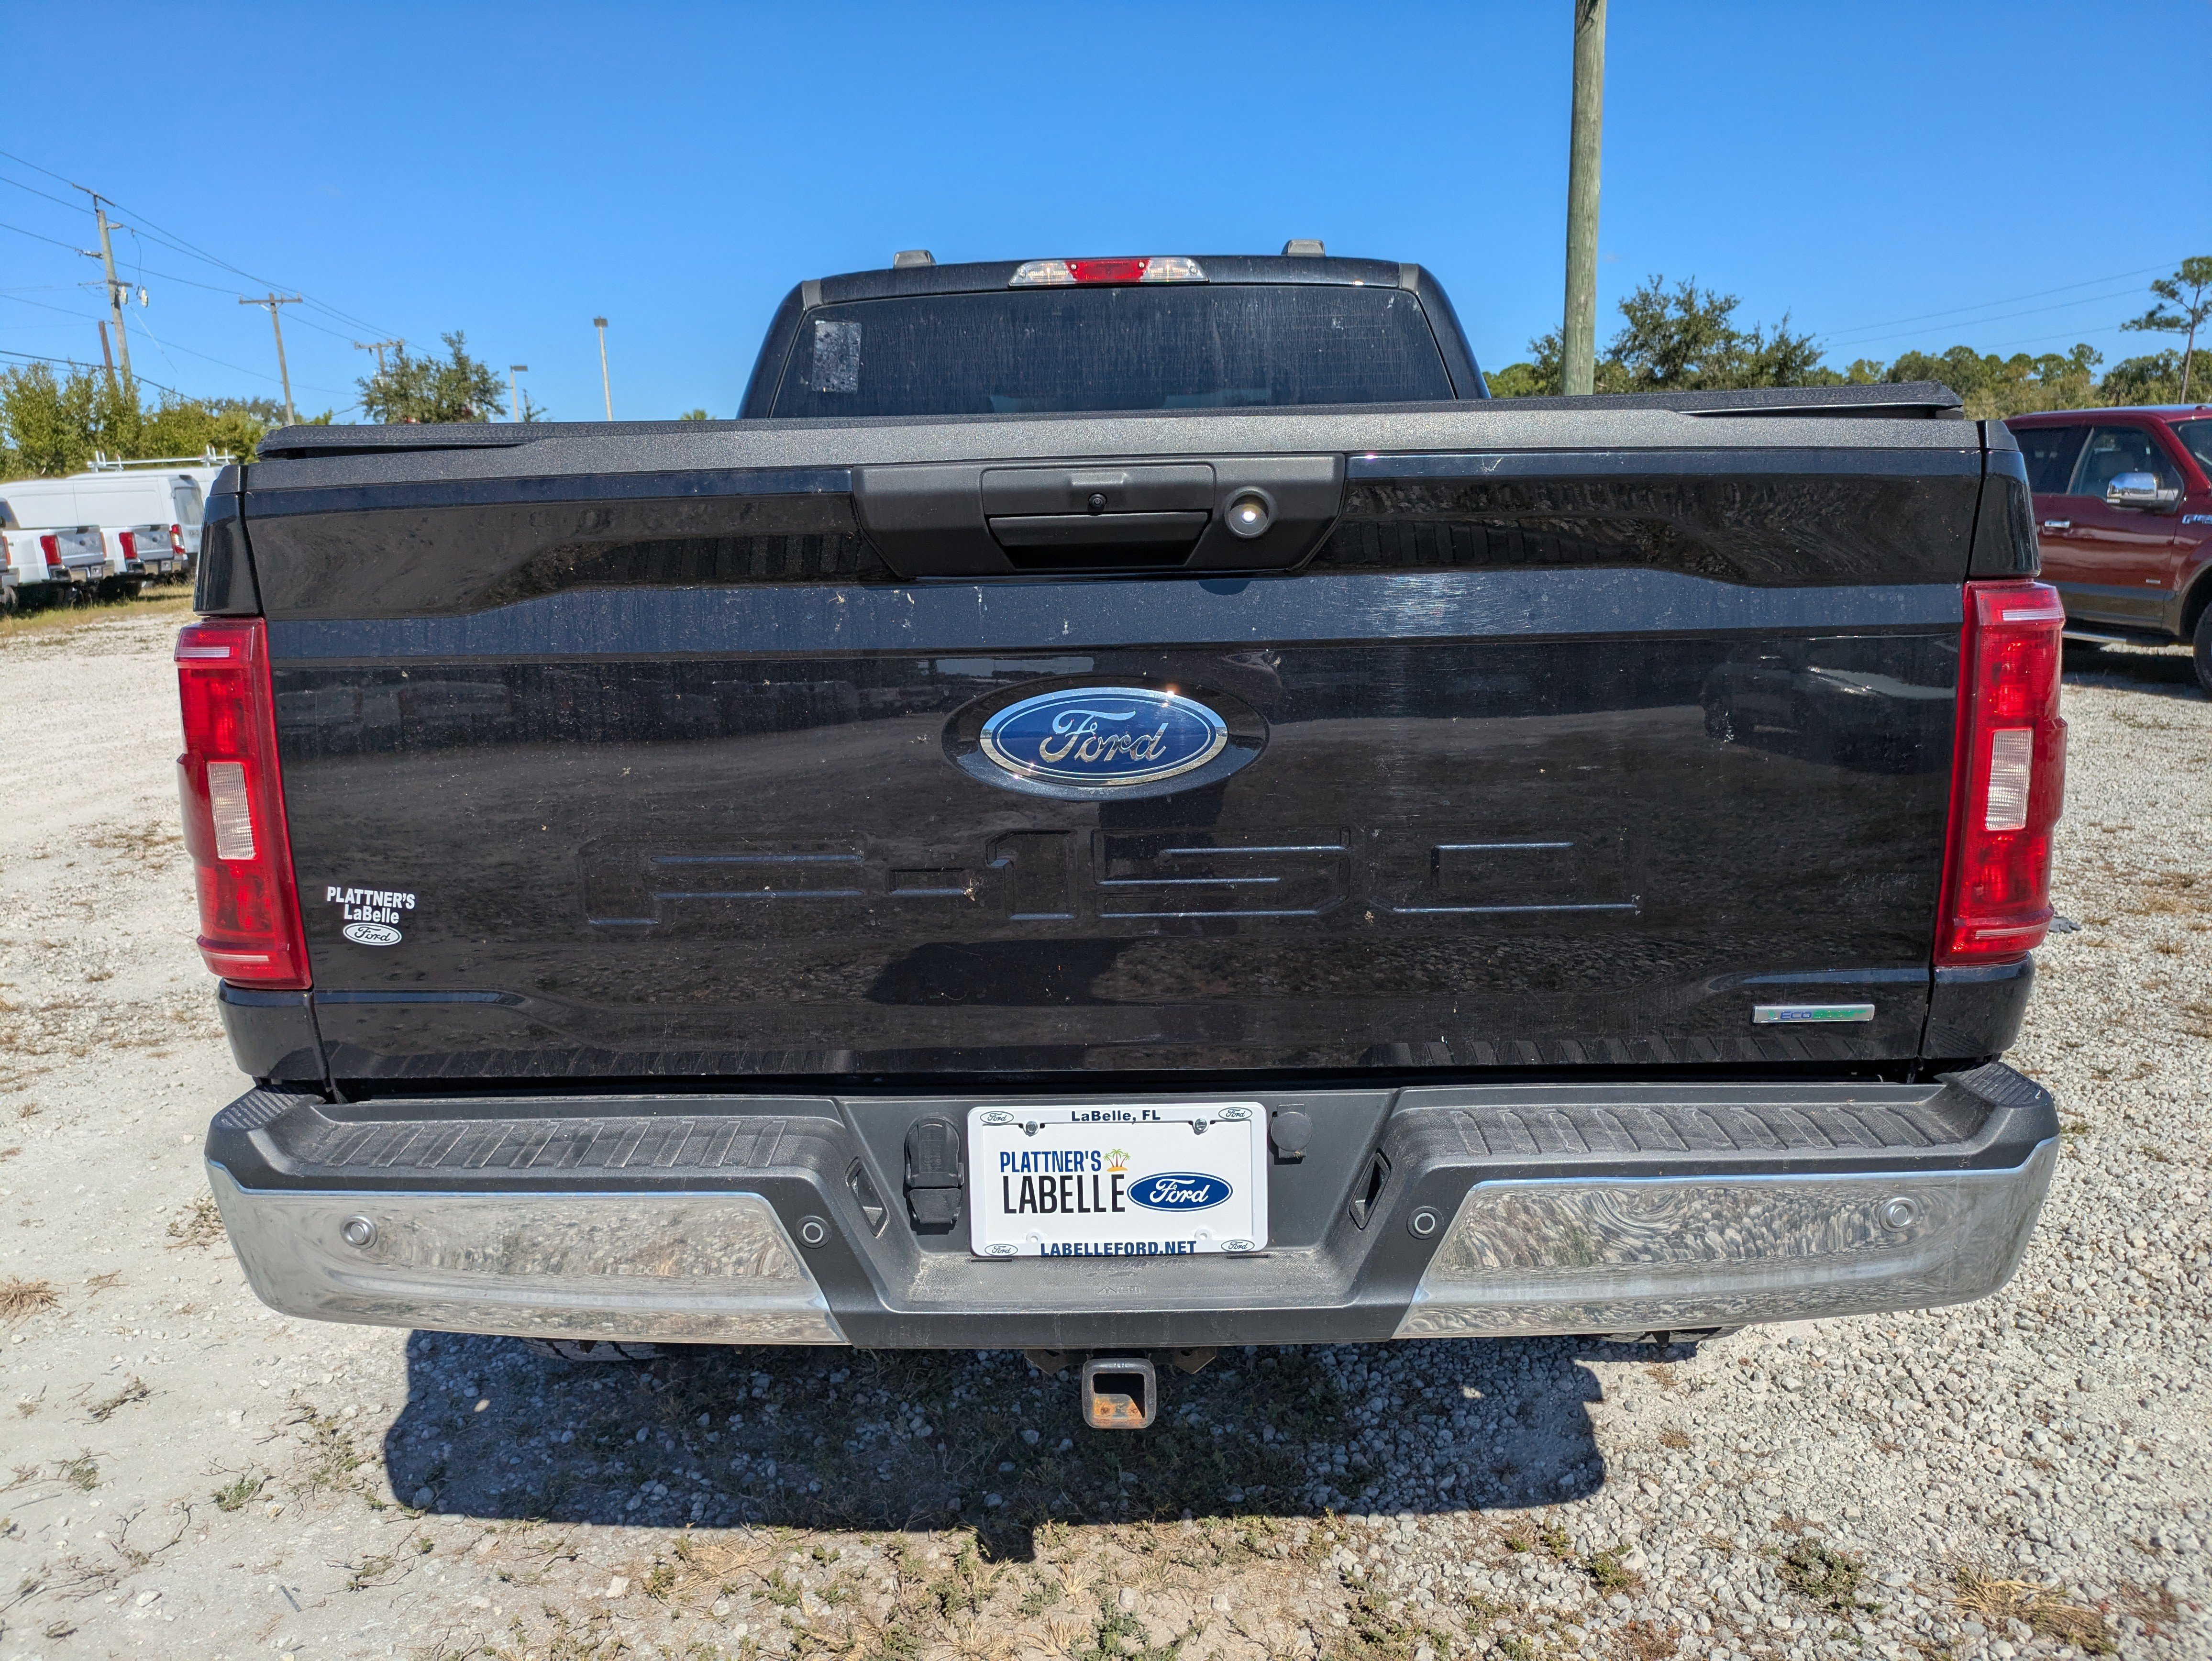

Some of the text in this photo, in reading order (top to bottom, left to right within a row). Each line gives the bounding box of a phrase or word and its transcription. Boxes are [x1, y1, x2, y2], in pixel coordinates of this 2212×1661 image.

[1039, 709, 1169, 762] Ford
[579, 825, 1638, 927] F-150
[327, 886, 415, 909] PLATTNER'S
[344, 904, 399, 924] LaBelle
[354, 926, 391, 941] Ford
[987, 1113, 1007, 1121] Ford
[1072, 1109, 1161, 1125] LaBelle, FL
[1226, 1108, 1246, 1118] Ford
[1000, 1150, 1101, 1173] PLATTNER'S
[1003, 1174, 1125, 1214] LABELLE
[1150, 1178, 1211, 1203] Ford
[992, 1245, 1011, 1253] Ford
[1040, 1240, 1197, 1256] LABELLEFORD.NET
[1228, 1241, 1248, 1250] Ford
